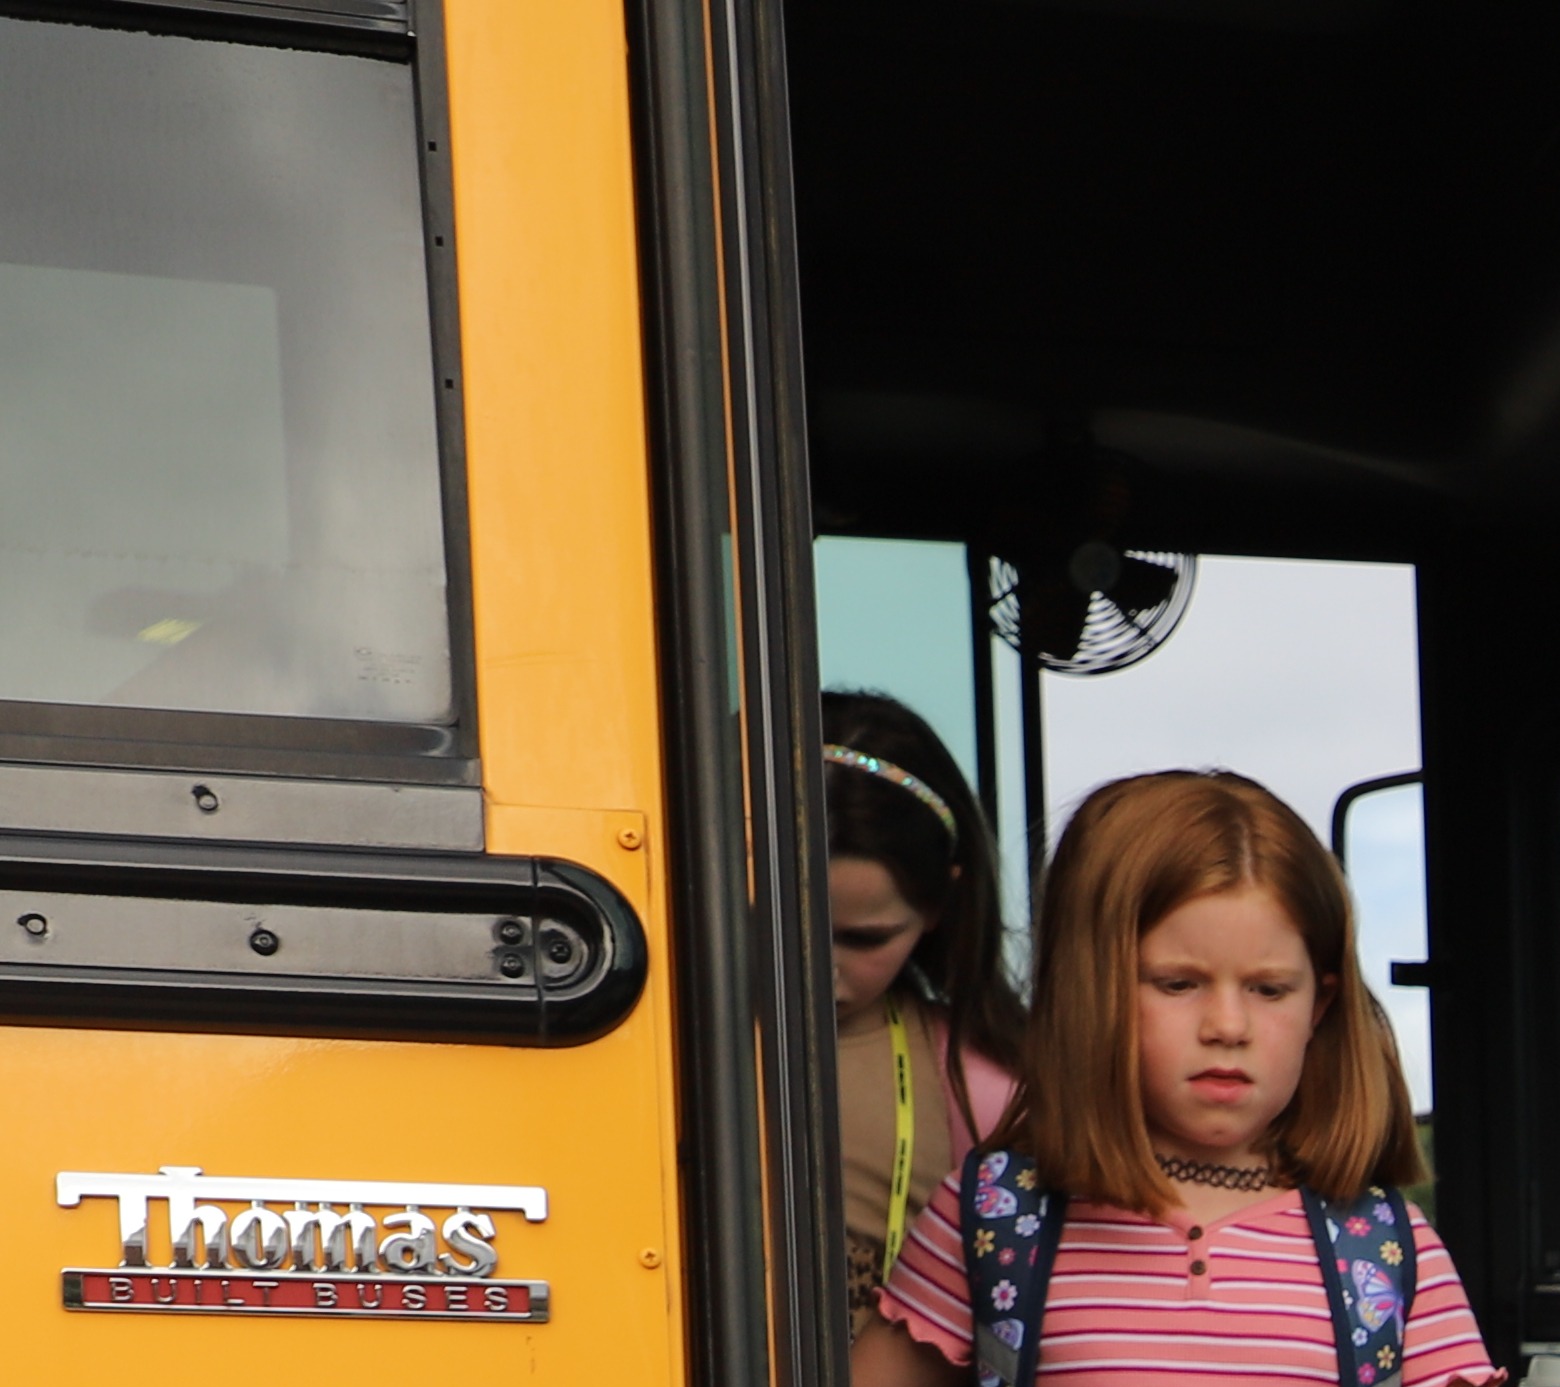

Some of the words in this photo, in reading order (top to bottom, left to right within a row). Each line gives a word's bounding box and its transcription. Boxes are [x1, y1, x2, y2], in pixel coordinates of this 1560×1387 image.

[56, 1166, 547, 1278] Thomas
[109, 1275, 279, 1307] BUILT
[312, 1281, 510, 1312] BUSES
